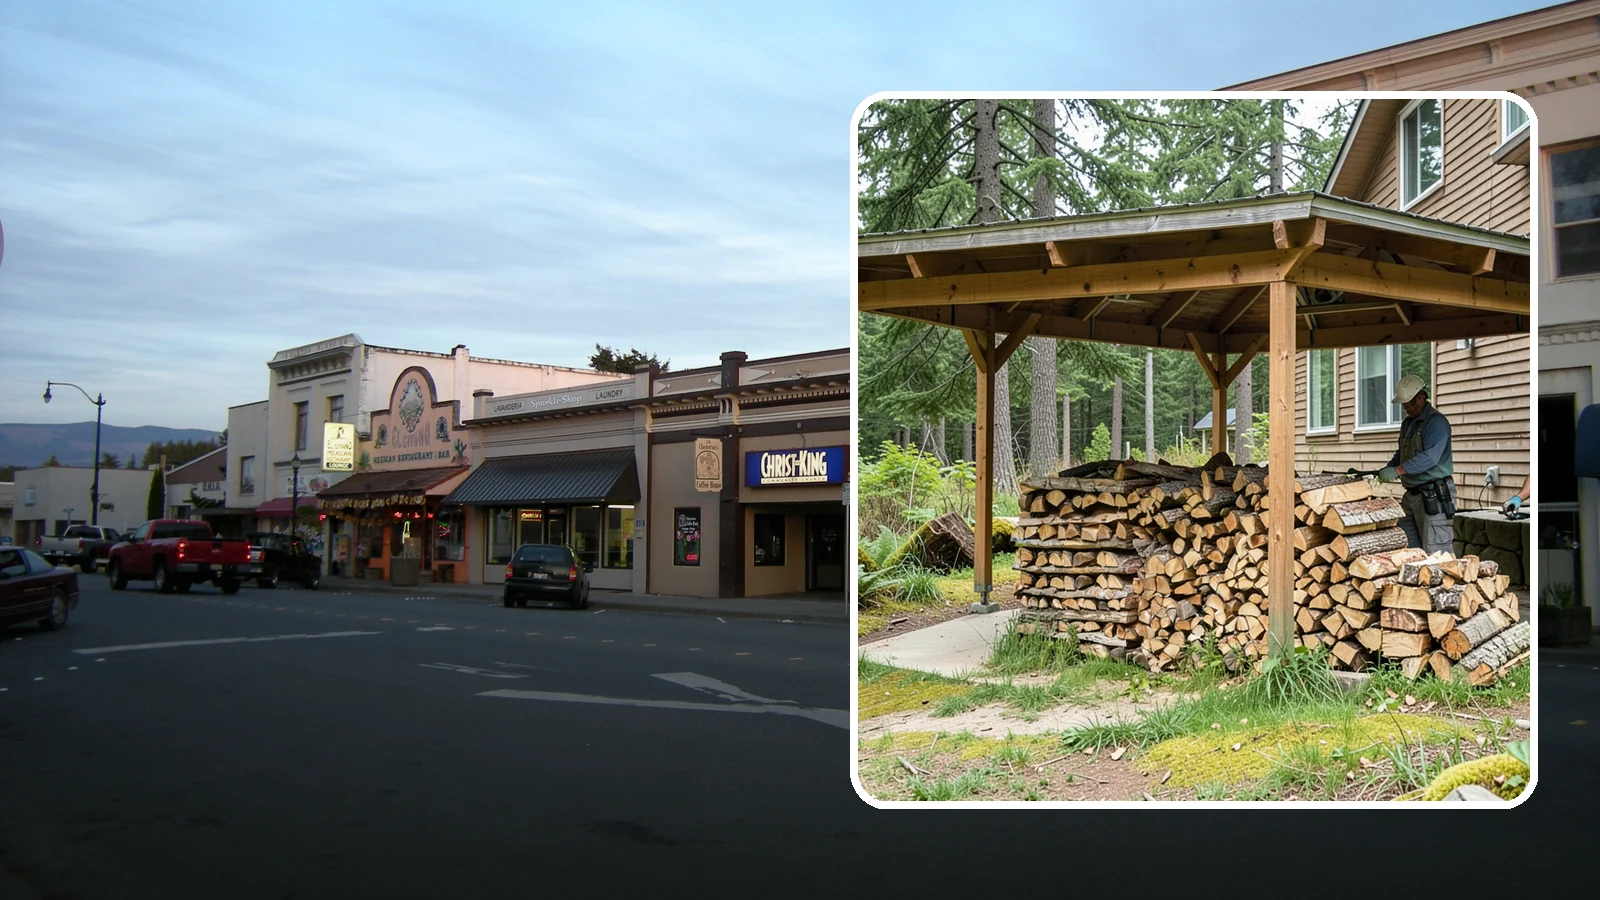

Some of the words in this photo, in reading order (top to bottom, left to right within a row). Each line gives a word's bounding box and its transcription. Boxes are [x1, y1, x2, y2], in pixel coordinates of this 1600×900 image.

[562, 394, 582, 404] Shop
[595, 389, 623, 399] LAUNDRY
[493, 402, 522, 412] LAVANDERIA
[392, 425, 402, 449] EL
[373, 455, 396, 465] MEXICAN
[397, 451, 433, 462] RESTAURANT
[438, 450, 450, 459] BAR
[761, 452, 797, 478] CHRIST
[800, 450, 827, 476] KING
